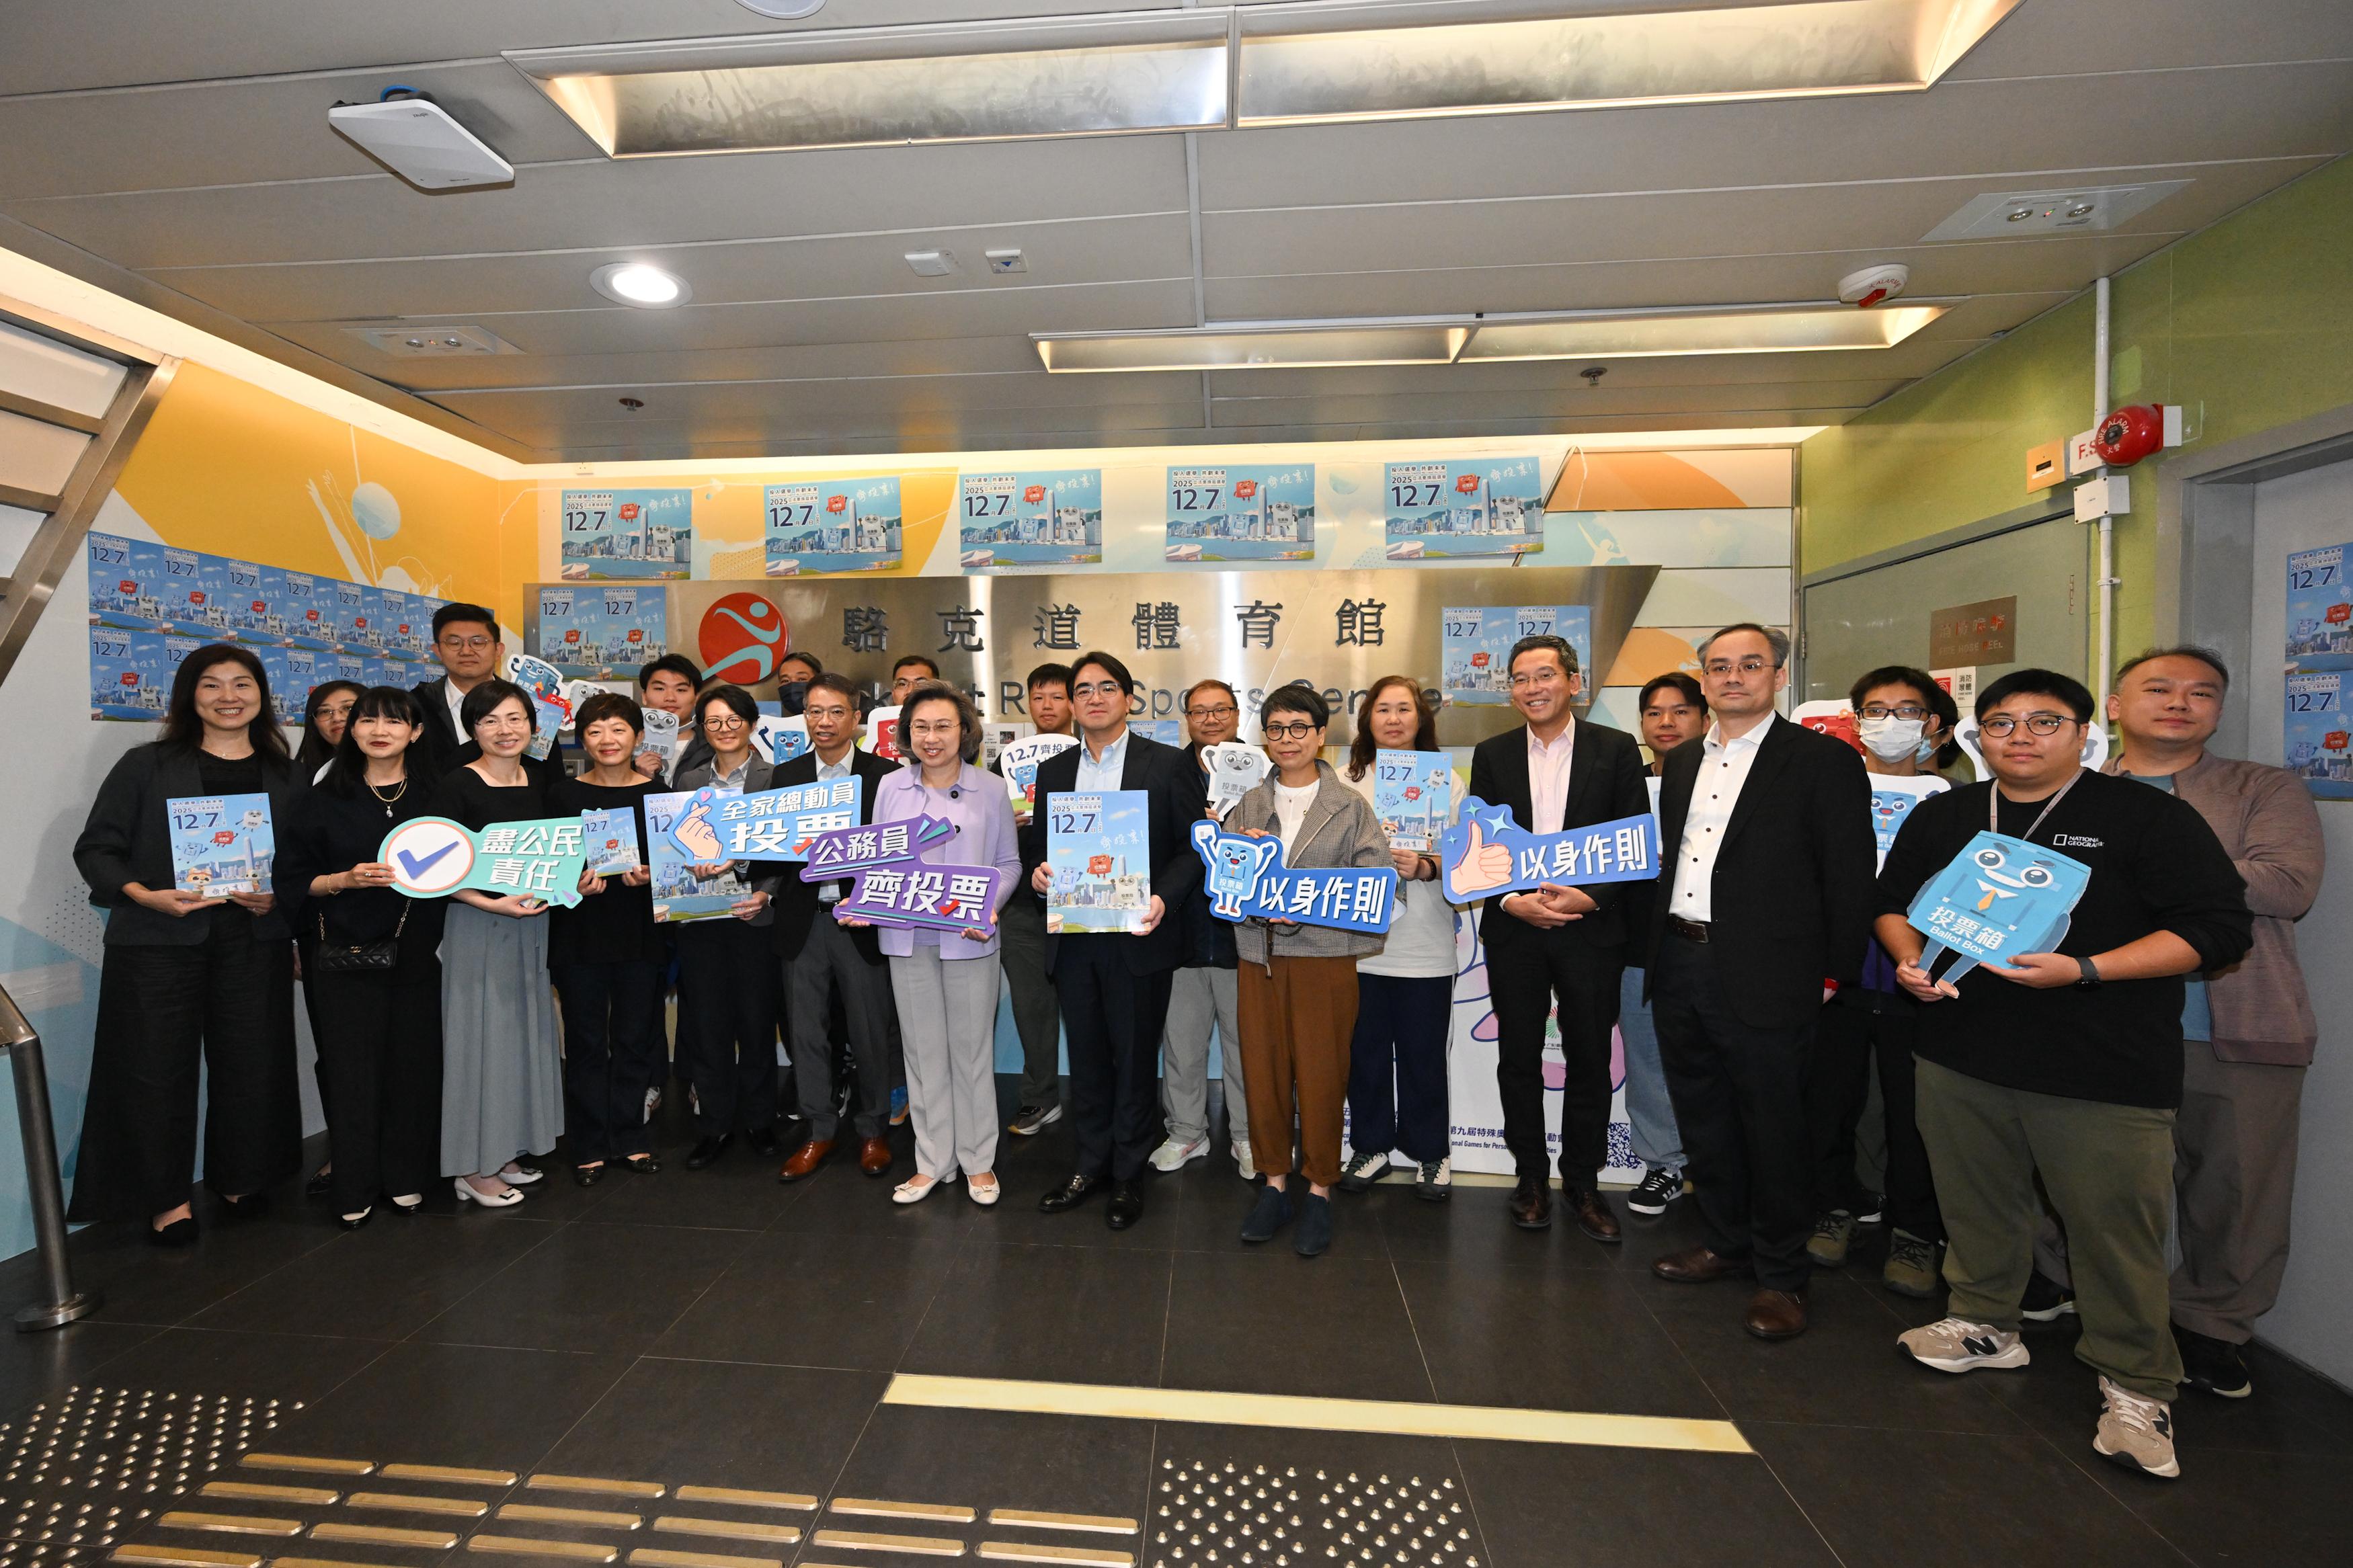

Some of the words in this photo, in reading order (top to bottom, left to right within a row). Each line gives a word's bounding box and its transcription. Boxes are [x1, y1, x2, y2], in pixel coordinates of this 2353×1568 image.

[2098, 428, 2107, 444] FIRE
[2108, 418, 2129, 434] ALARM
[1958, 643, 1979, 653] HOSE
[720, 781, 854, 822] 全家總動員
[479, 825, 583, 856] 盡公民
[815, 825, 909, 866] 公務員
[1521, 825, 1648, 880] 以身作則
[487, 858, 559, 892] 責任
[858, 870, 990, 921] 齊投票
[1259, 876, 1387, 924] 以身作則
[1927, 905, 2007, 951] 投票箱
[1929, 925, 1962, 944] Ballot
[1962, 940, 1985, 955] Box
